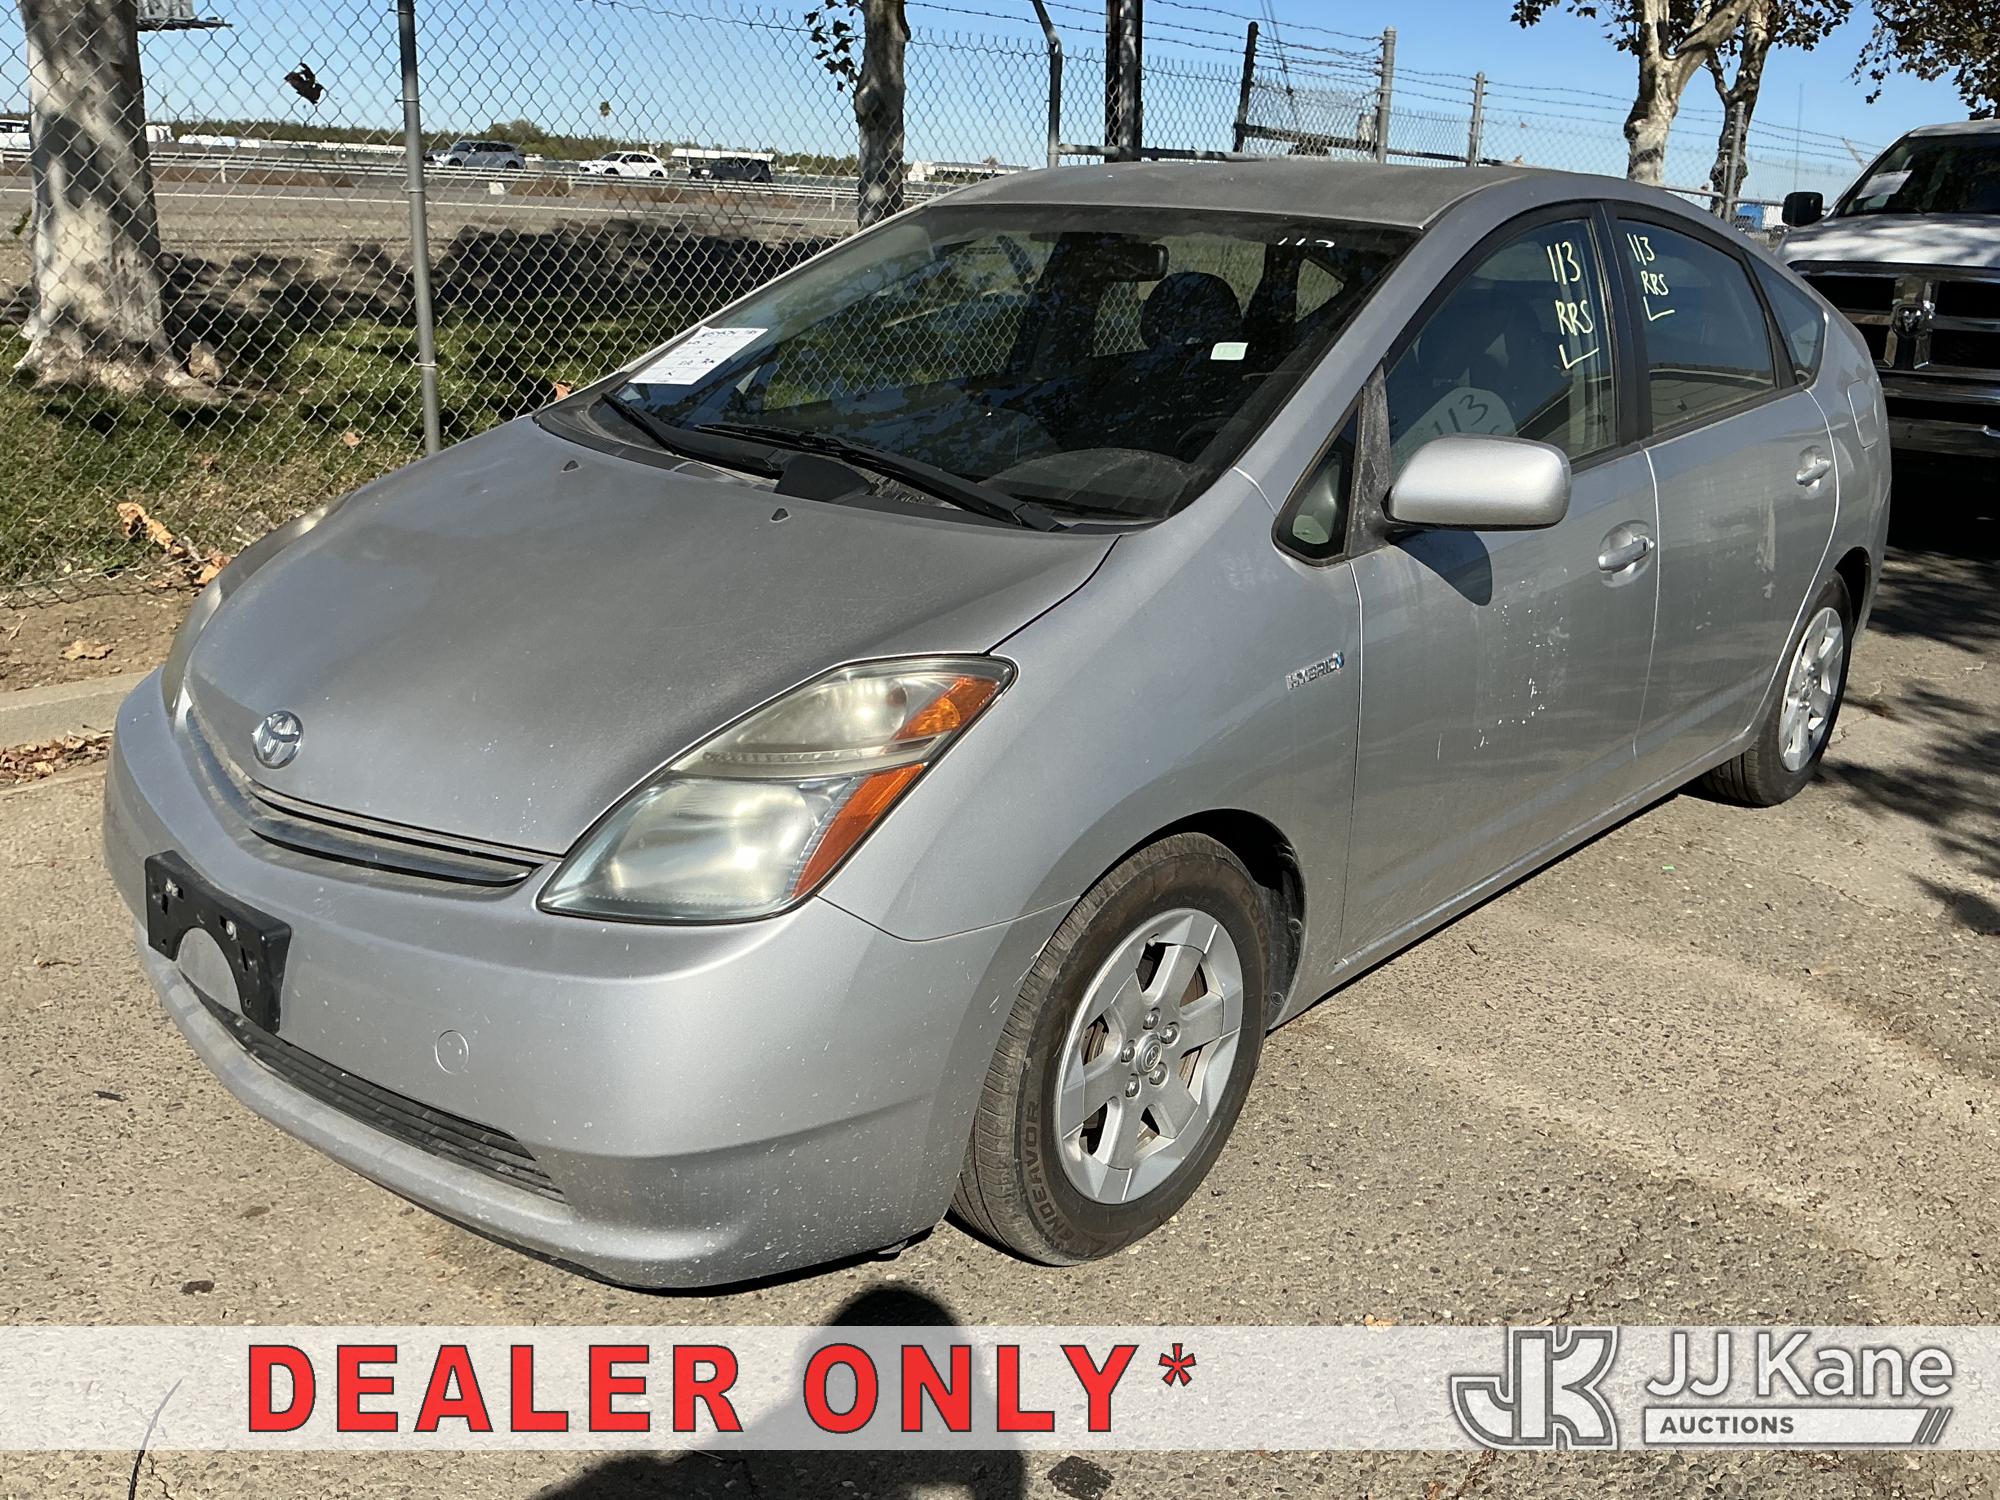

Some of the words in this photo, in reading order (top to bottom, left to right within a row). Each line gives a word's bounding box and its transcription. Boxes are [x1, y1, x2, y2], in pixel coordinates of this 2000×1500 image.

[1546, 240, 1582, 286] 113
[1627, 233, 1656, 266] 113
[1640, 270, 1670, 297] RRS
[1554, 299, 1594, 337] RRS
[1285, 650, 1345, 692] HYBRID
